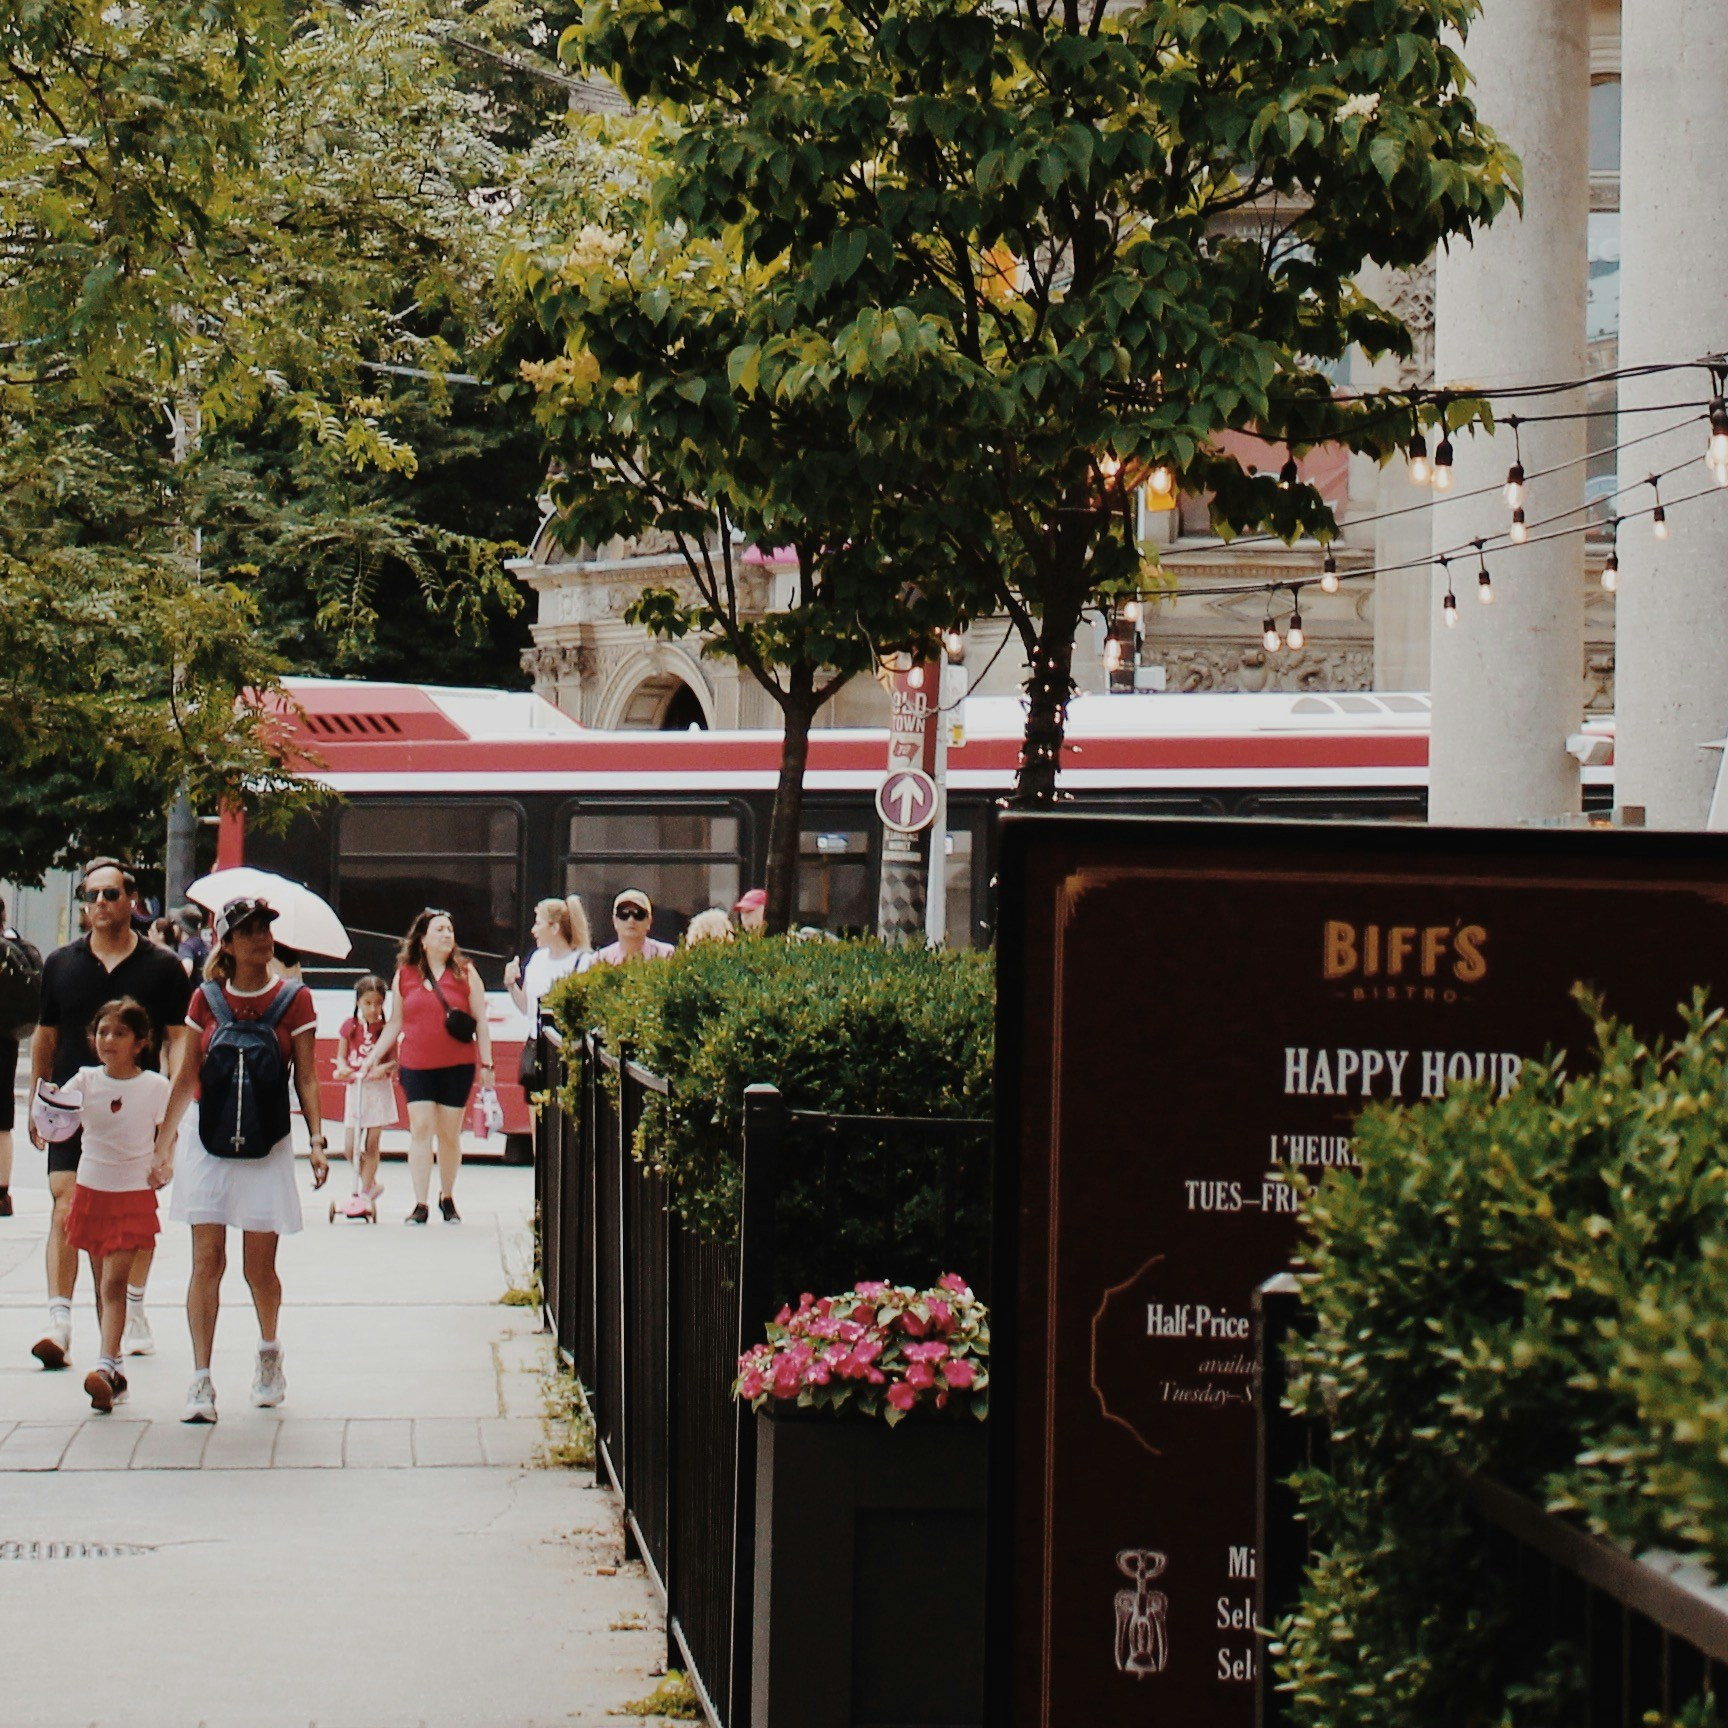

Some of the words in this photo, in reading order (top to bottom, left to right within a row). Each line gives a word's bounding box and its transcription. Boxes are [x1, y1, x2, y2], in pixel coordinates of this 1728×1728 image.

[1323, 917, 1488, 984] BIFF'S
[1352, 984, 1458, 1003] BISTRO
[1284, 1047, 1410, 1097] HAPPY
[1421, 1050, 1524, 1100] HOUR
[1146, 1303, 1250, 1339] Half-Price
[1228, 1545, 1257, 1578] Mi
[1217, 1647, 1257, 1681] Sel
